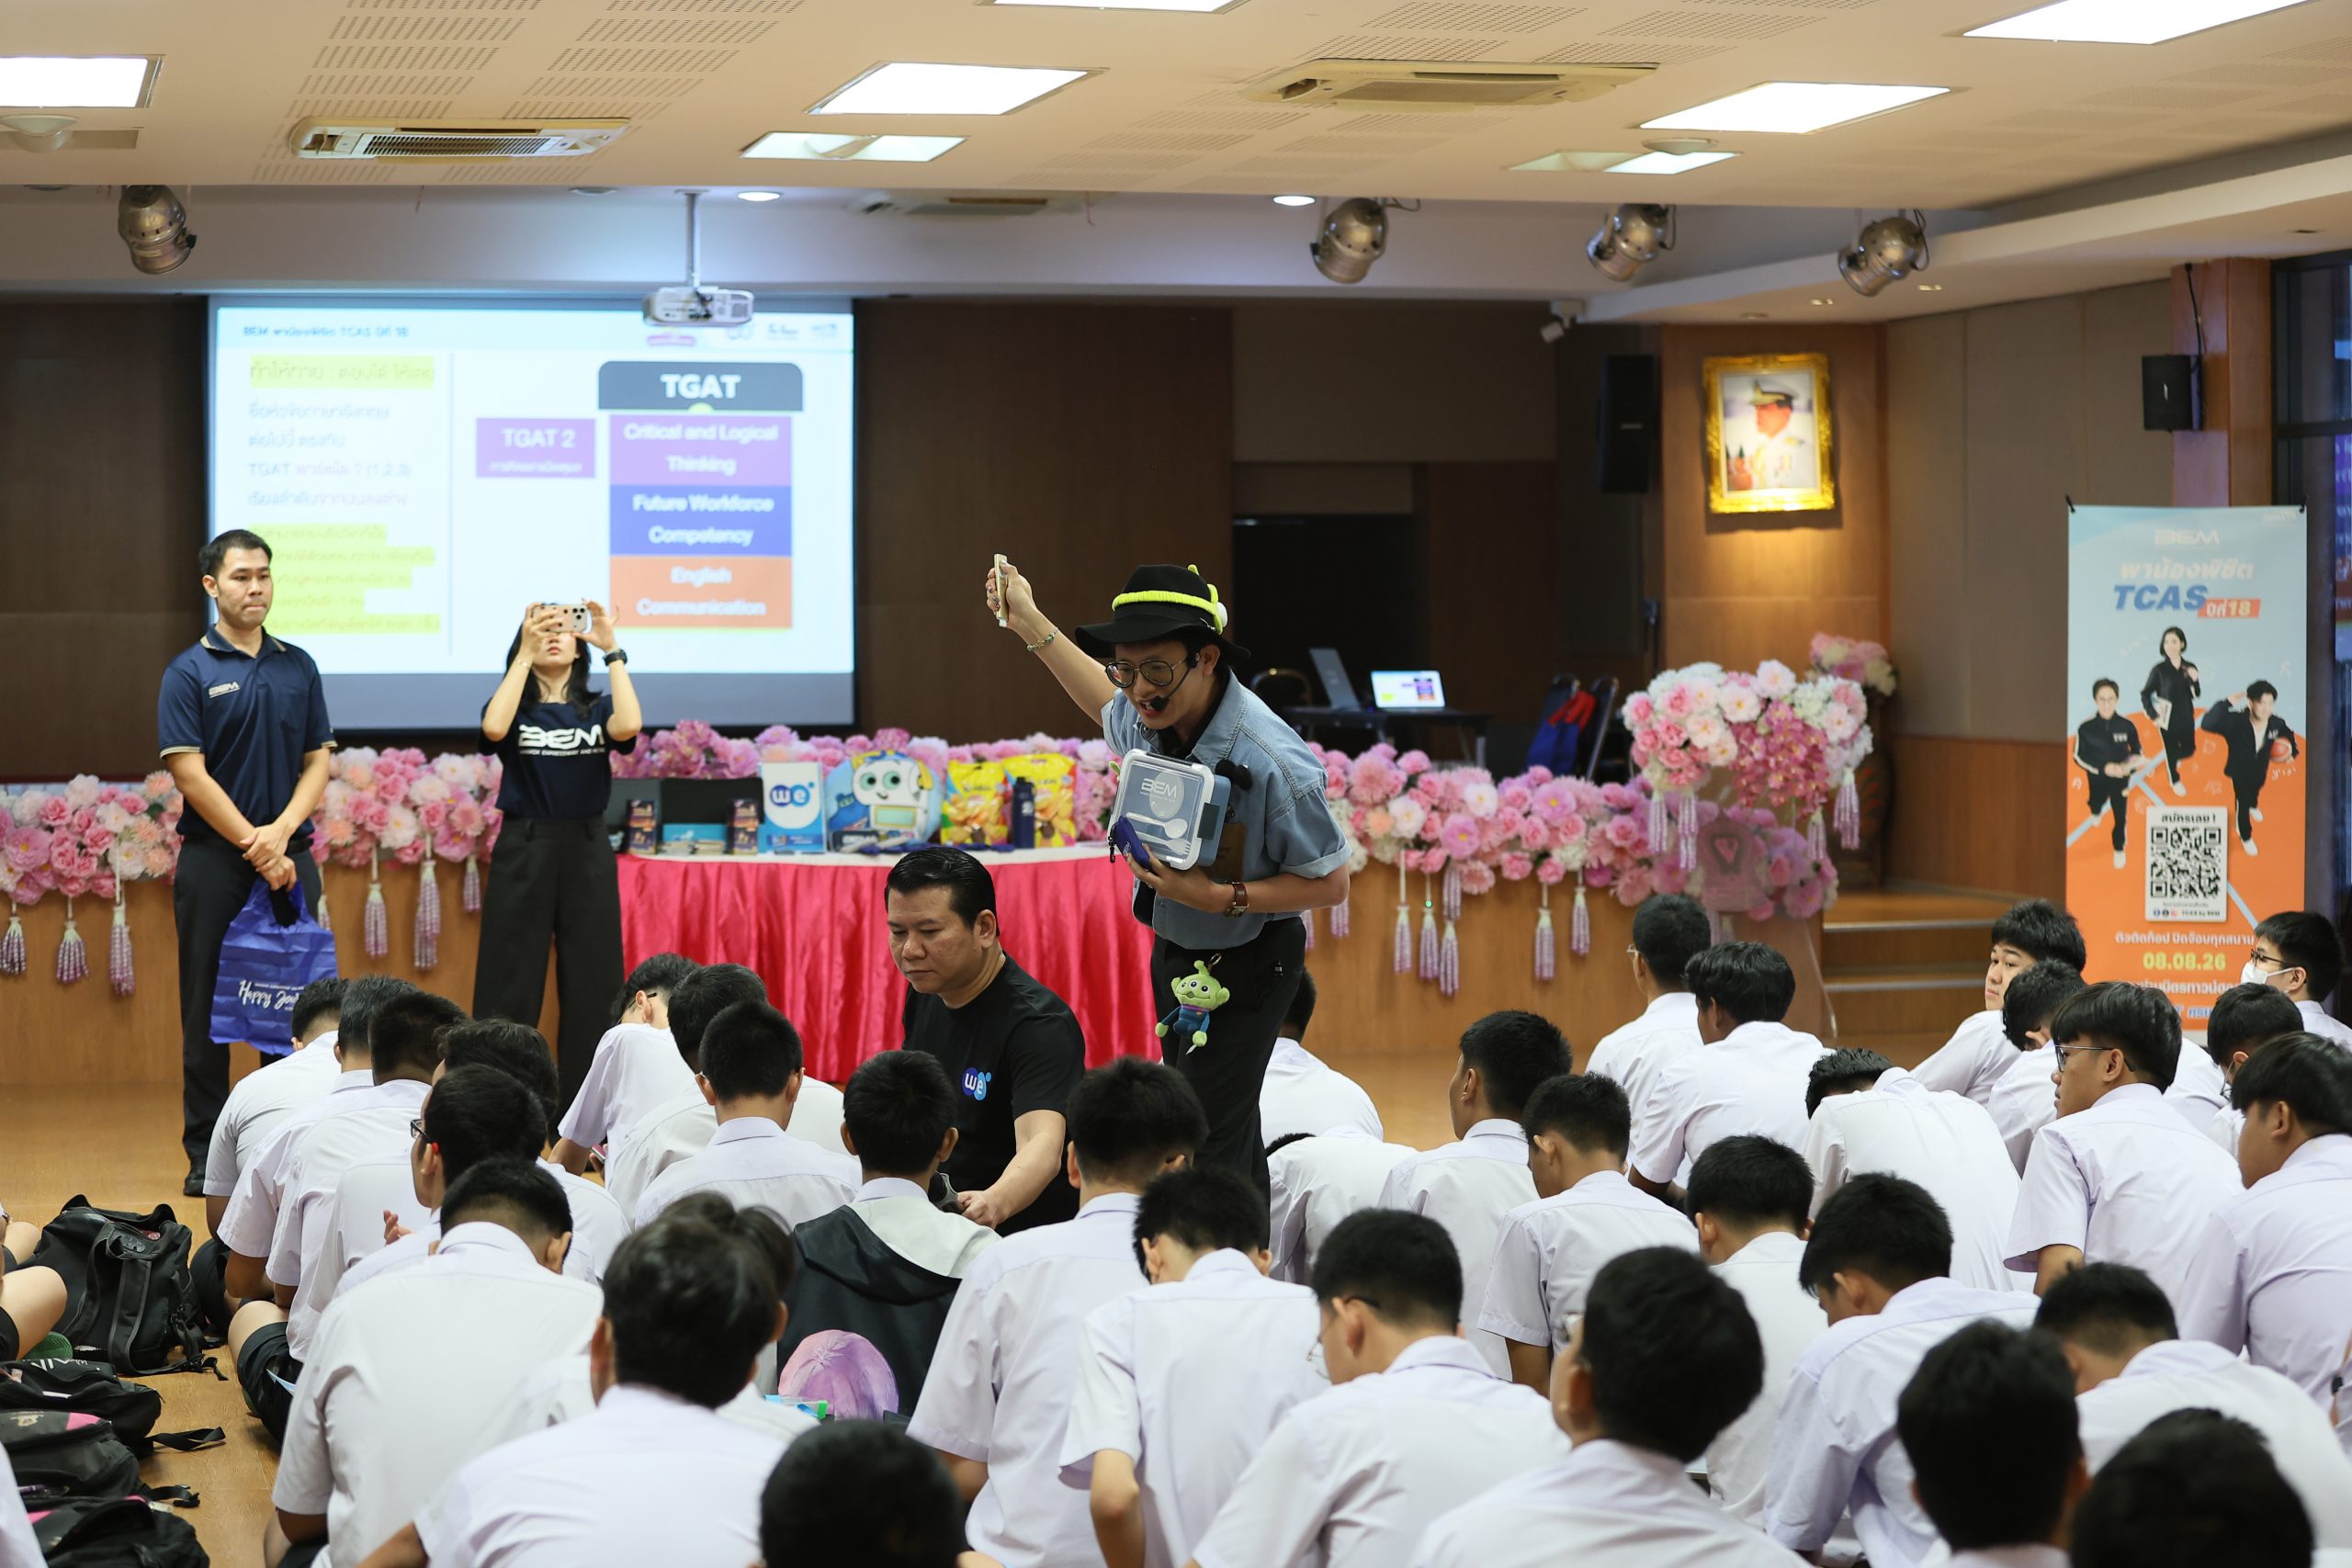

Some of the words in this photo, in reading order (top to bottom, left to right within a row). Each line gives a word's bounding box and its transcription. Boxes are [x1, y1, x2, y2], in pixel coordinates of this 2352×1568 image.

[660, 374, 742, 399] TGAT
[502, 428, 558, 448] TGAT
[561, 429, 576, 448] 2
[623, 423, 682, 441] Critical
[684, 424, 717, 441] and
[719, 424, 779, 445] Logical
[248, 463, 291, 477] TGAT
[666, 456, 737, 476] Thinking
[632, 494, 687, 513] Future
[690, 494, 775, 513] Workforce
[648, 525, 754, 547] Competency
[2154, 528, 2220, 545] BEM
[670, 566, 732, 587] English
[2120, 557, 2255, 581] พาน้องพิชิต
[636, 598, 767, 616] Communication
[2114, 583, 2209, 612] TCAS
[518, 724, 605, 750] BEM
[771, 787, 808, 805] we
[1140, 777, 1177, 798] BEM
[2143, 952, 2226, 971] 08.08.26
[239, 979, 272, 1009] Happy
[964, 1070, 985, 1097] we
